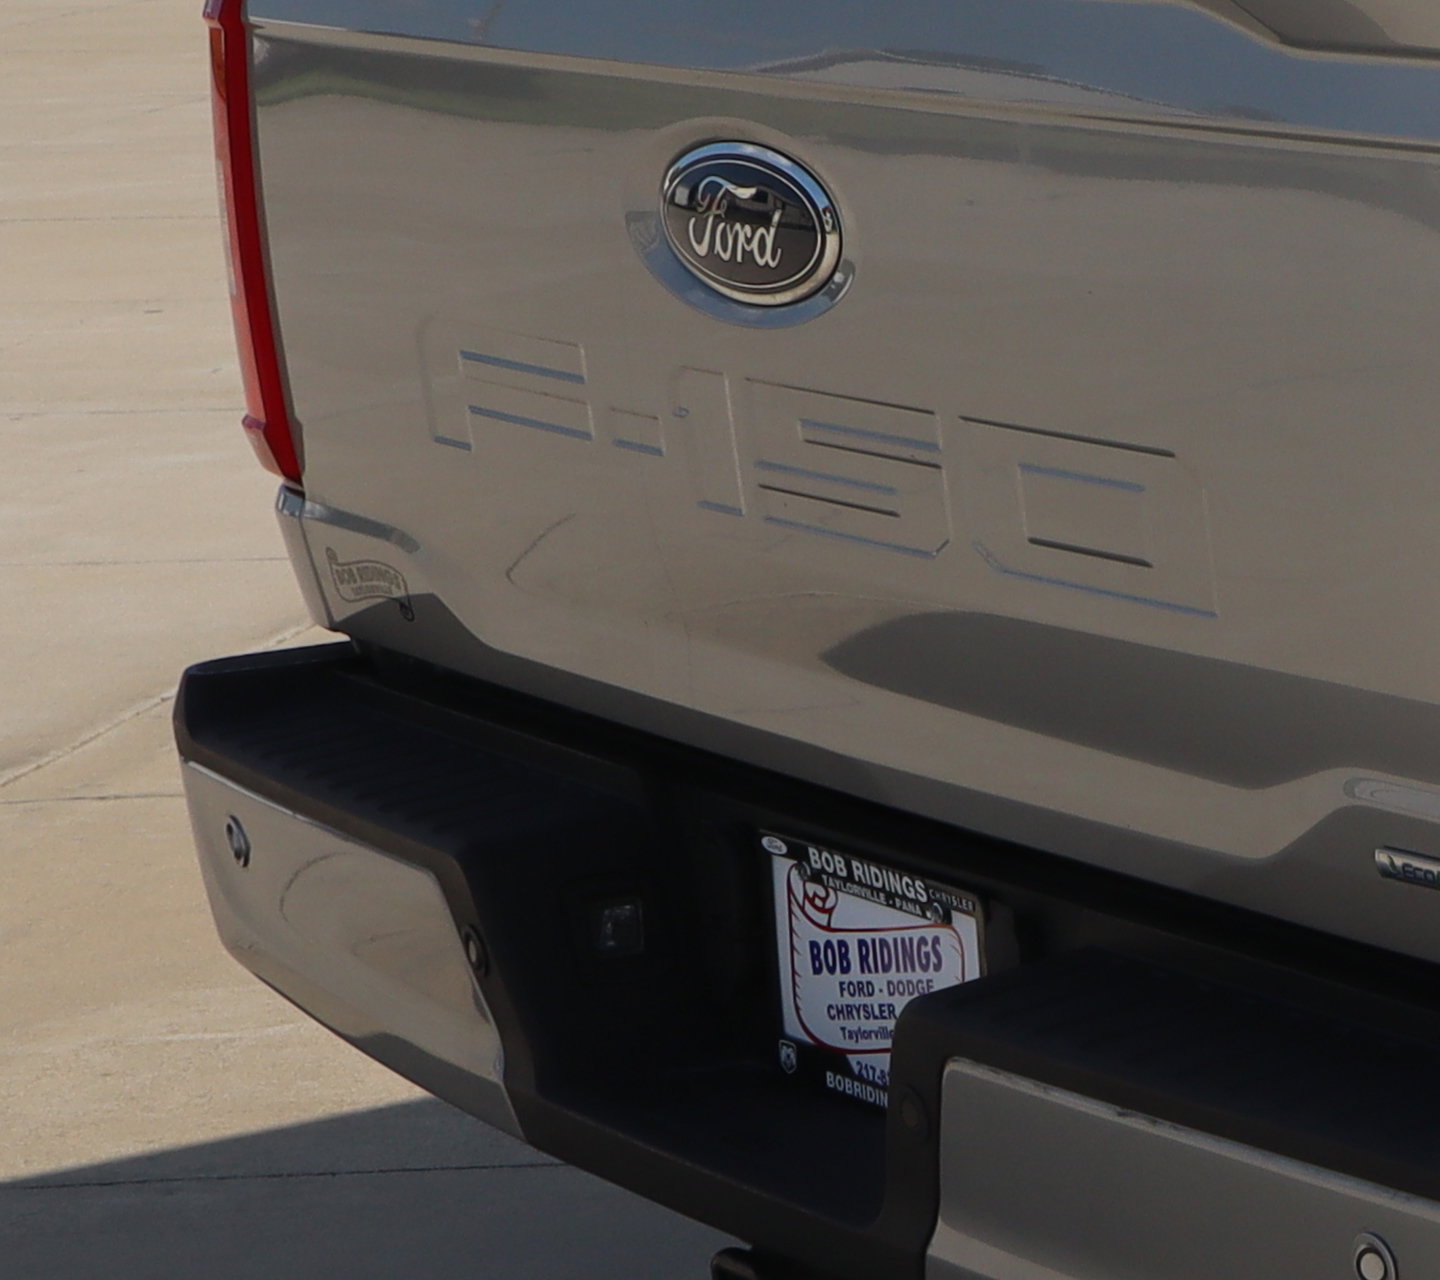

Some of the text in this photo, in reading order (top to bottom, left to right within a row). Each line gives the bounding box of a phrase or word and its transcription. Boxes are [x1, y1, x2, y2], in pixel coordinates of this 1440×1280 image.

[688, 175, 783, 269] Ford
[807, 846, 928, 903] BOB RIDINGS
[821, 874, 922, 918] TAYLORVILLE PANA
[929, 888, 975, 913] CHRYSLER
[808, 934, 943, 976] BOB RIDINGS
[838, 980, 876, 998] FORD
[826, 1003, 898, 1022] CHRYSLER
